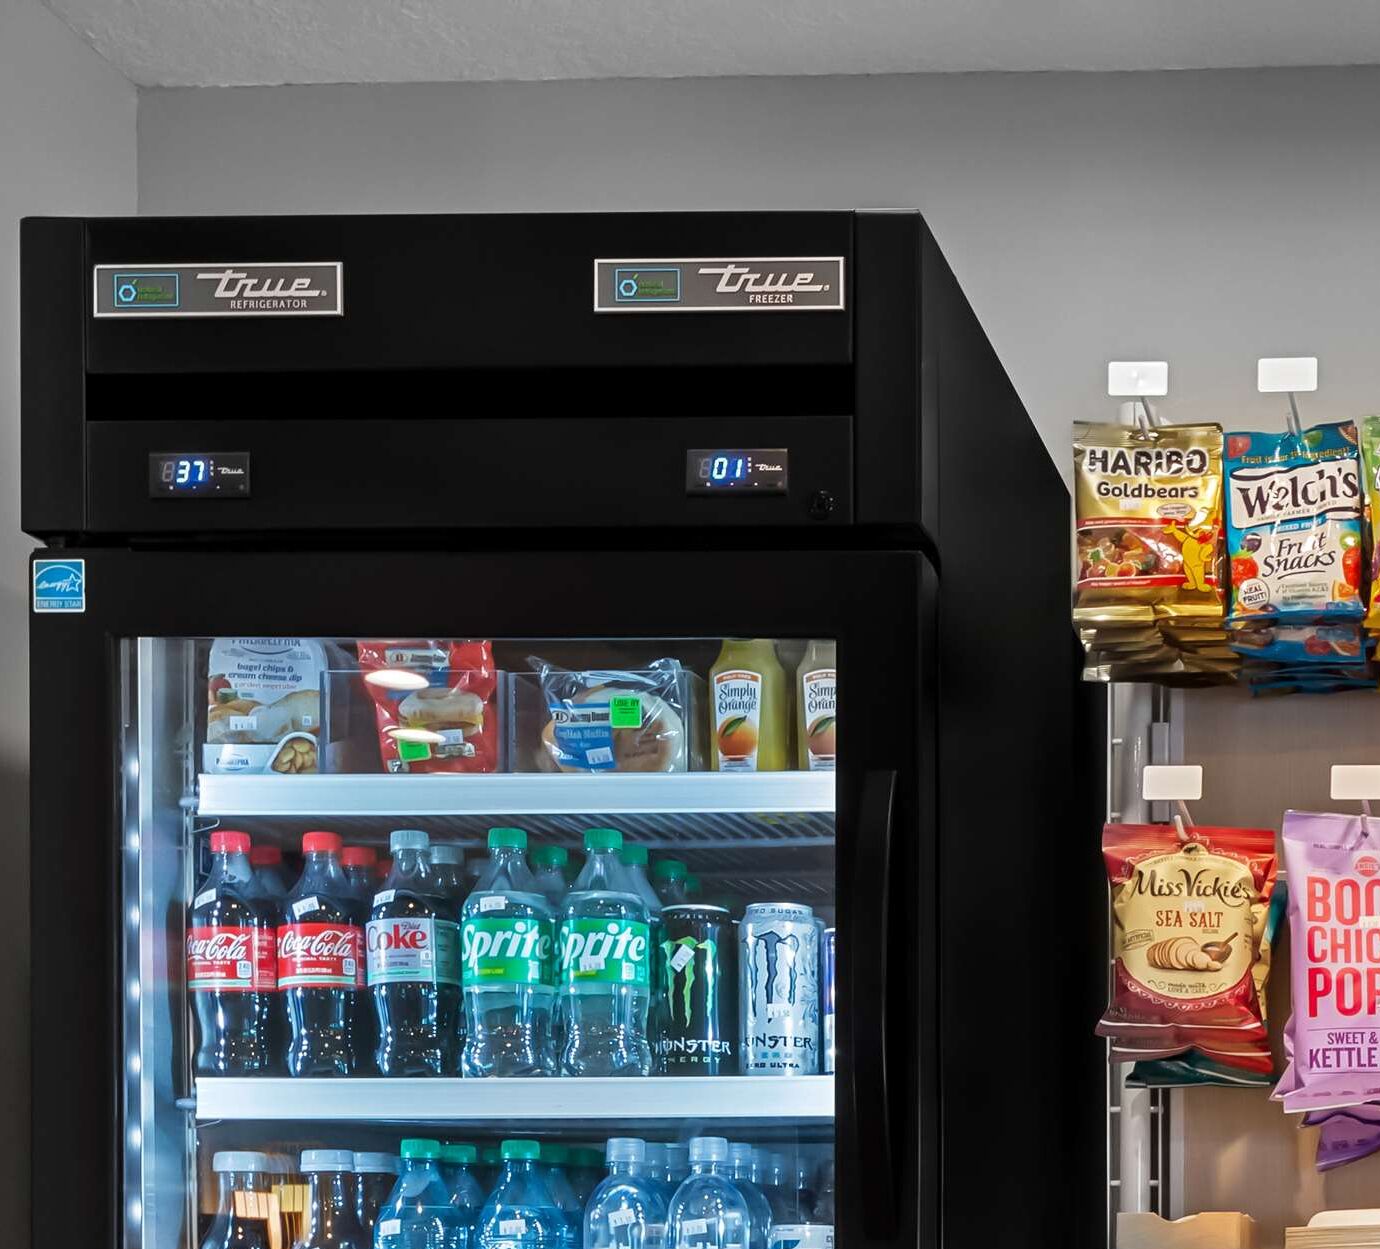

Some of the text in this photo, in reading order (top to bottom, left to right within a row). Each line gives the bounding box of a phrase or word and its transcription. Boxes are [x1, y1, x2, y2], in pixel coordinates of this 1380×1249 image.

[196, 269, 321, 298] true
[698, 264, 823, 292] true
[230, 300, 307, 309] REFRIGERATOR
[749, 294, 793, 303] FREEZER
[176, 461, 205, 483] 37
[712, 457, 743, 479] 01
[1088, 449, 1208, 476] HARIBO
[1097, 482, 1198, 498] Goldbears
[1237, 467, 1358, 518] Welch's
[1262, 550, 1336, 577] Snacks
[228, 673, 284, 681] cream cheese
[262, 664, 286, 673] chips
[718, 684, 756, 700] Simply
[718, 699, 756, 714] Orange
[1130, 868, 1252, 908] Miss Vickie's
[1156, 910, 1224, 929] SEA SALT
[366, 919, 427, 952] Coke
[462, 922, 549, 972] Sprite
[562, 922, 645, 972] Sprite
[1327, 1032, 1366, 1045] SWEET
[1370, 1032, 1378, 1044] &
[1309, 1047, 1378, 1069] KETTLE
